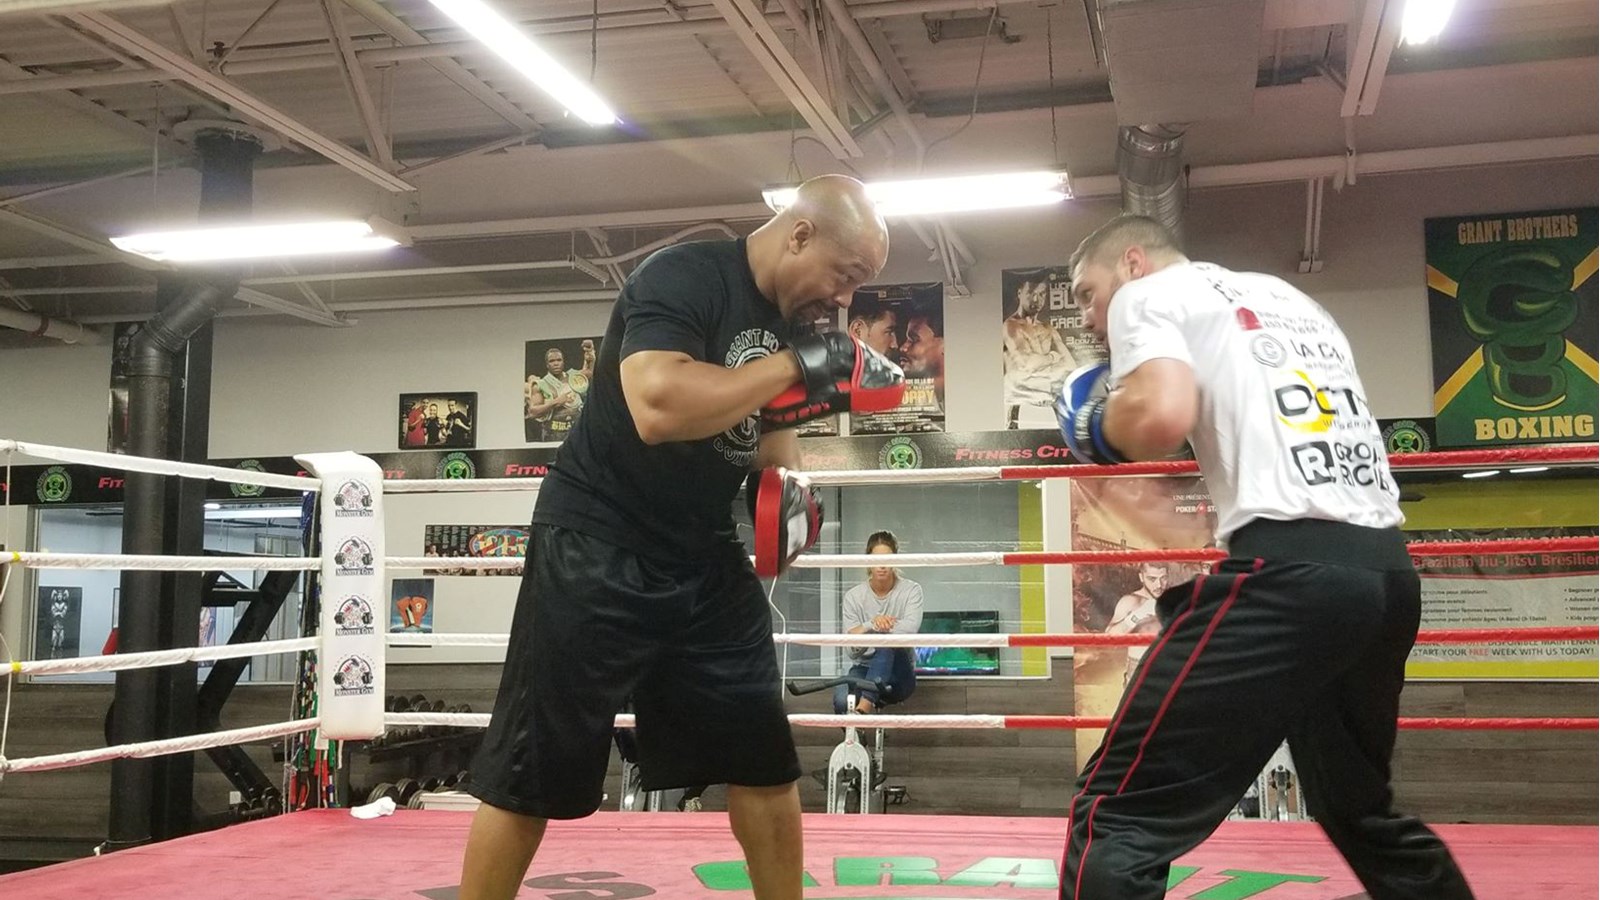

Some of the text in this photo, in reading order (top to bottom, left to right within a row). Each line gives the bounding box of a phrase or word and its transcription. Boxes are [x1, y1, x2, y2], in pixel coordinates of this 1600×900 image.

[1458, 215, 1578, 245] GRANT BROTHERS
[1051, 316, 1083, 330] GRAC
[725, 328, 780, 369] GRANT BRO
[1275, 384, 1366, 416] OCT
[1475, 414, 1594, 441] BOXING
[955, 445, 1070, 461] FITNESS CIT
[505, 463, 549, 476] FITN
[98, 476, 126, 489] FIT
[1175, 505, 1196, 513] POKER
[1412, 555, 1474, 568] Brazilian
[1413, 648, 1440, 656] START
[1441, 648, 1467, 656] YOUR
[1468, 648, 1489, 656] FREE
[1492, 648, 1514, 656] WEEK
[1518, 648, 1543, 656] WITH
[1559, 647, 1594, 655] TODAY!
